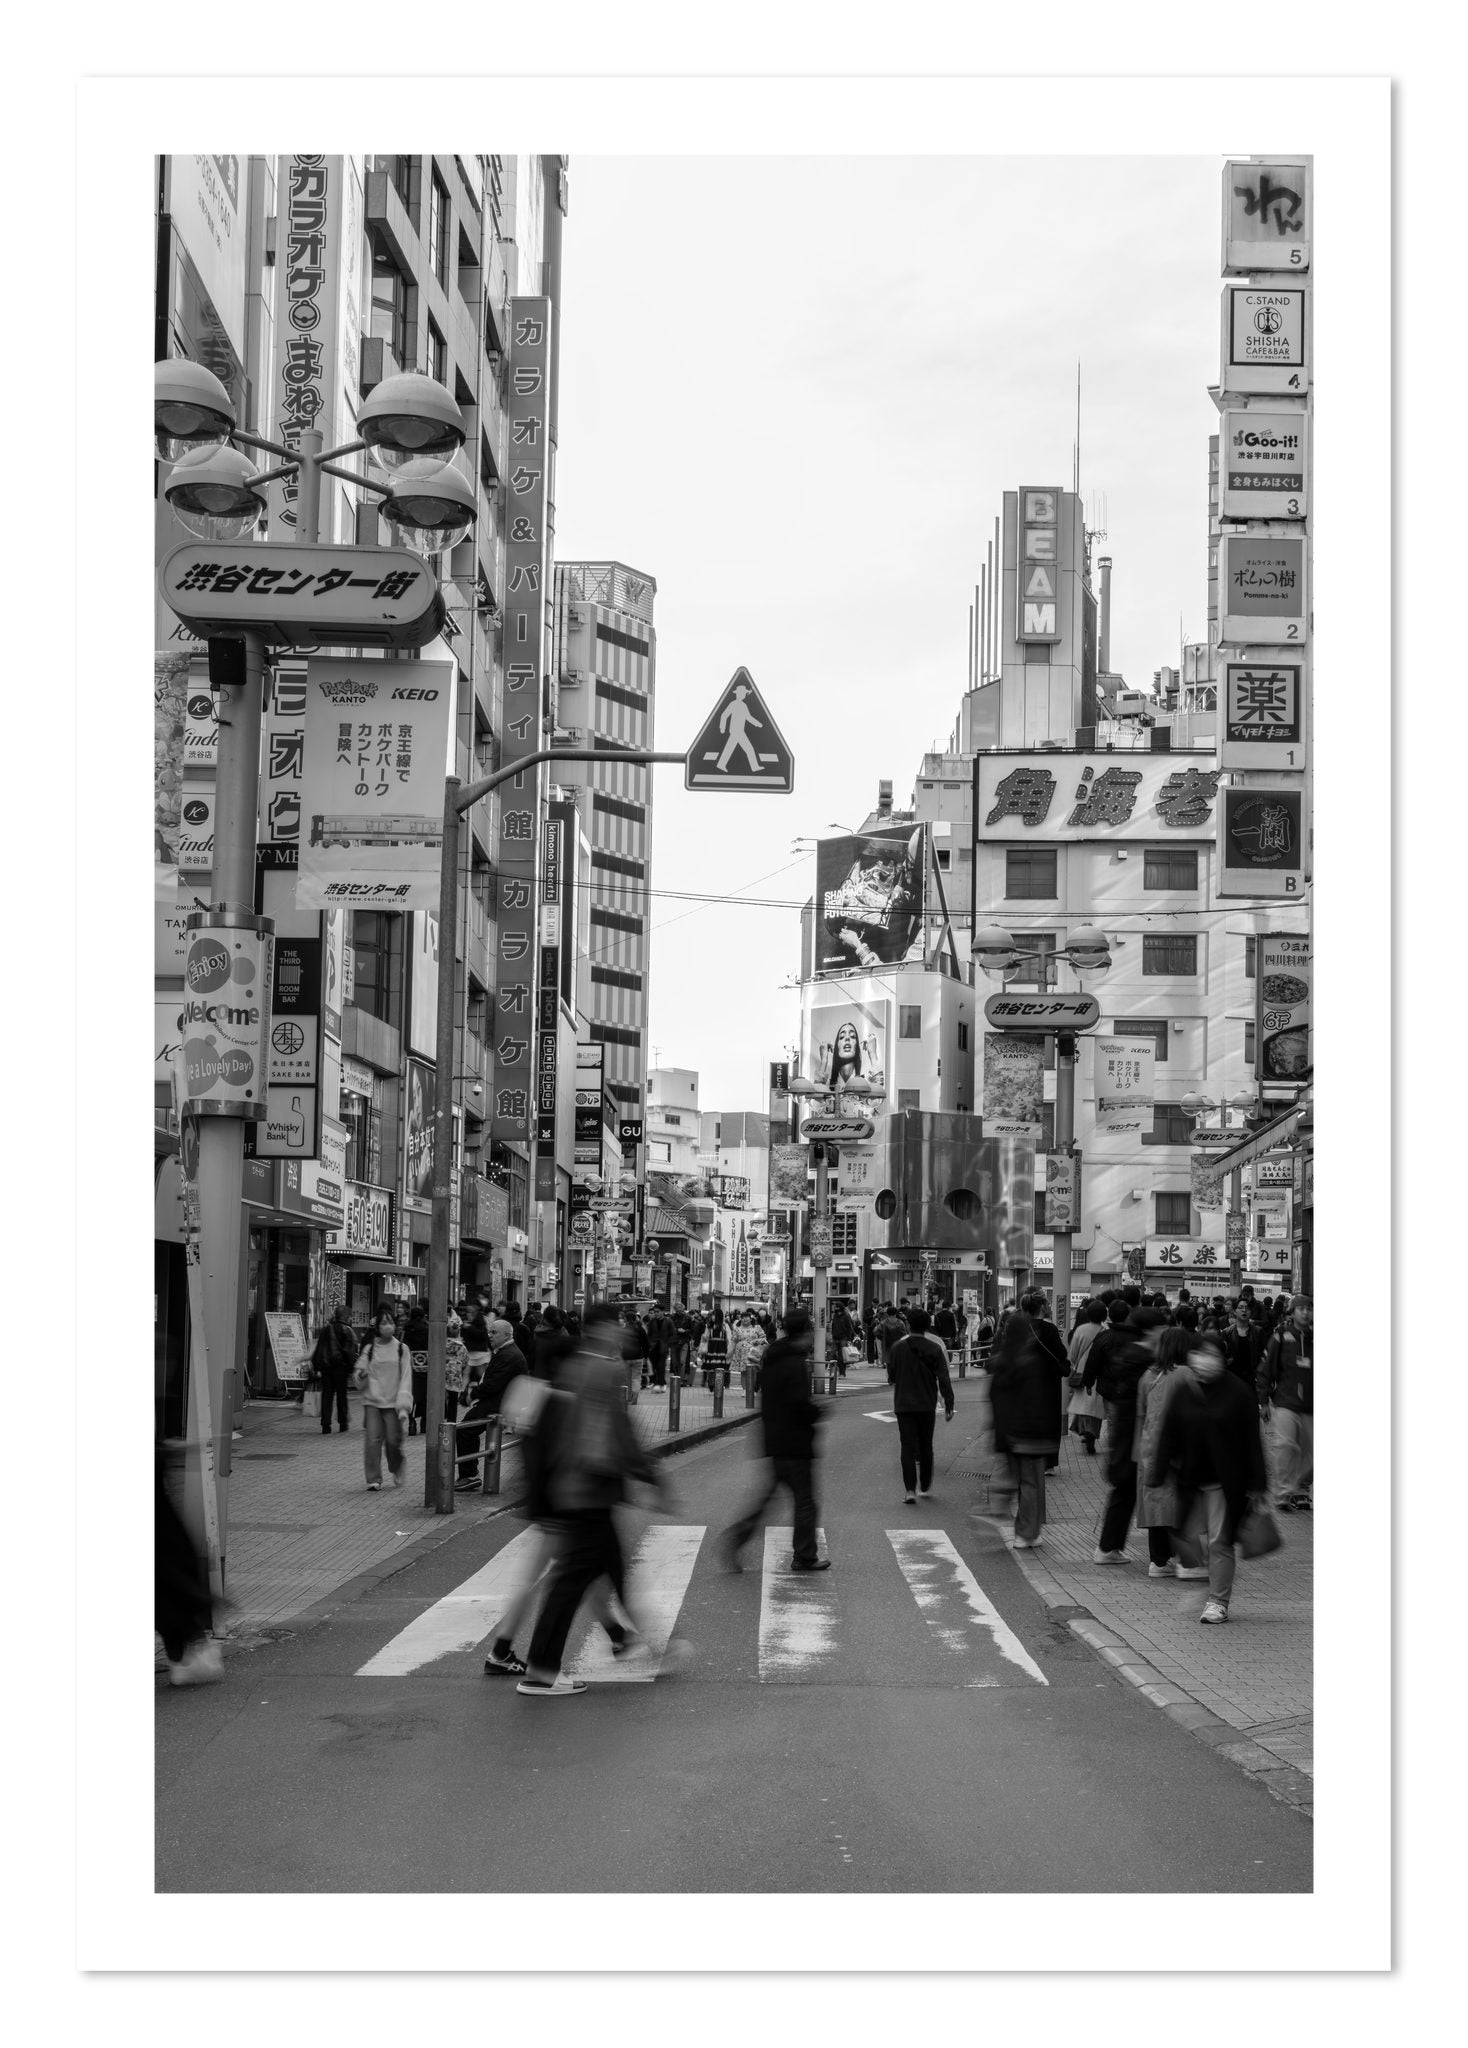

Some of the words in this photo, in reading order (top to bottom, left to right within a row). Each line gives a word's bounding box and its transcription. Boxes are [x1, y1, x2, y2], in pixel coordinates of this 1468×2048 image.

[1234, 175, 1302, 236] わん
[287, 166, 327, 302] カラオケ
[1290, 250, 1301, 264] 5
[1246, 296, 1290, 305] C.STAND
[1246, 336, 1290, 346] SHISHA
[1246, 347, 1290, 355] CAFE&BAR
[1288, 374, 1300, 388] 4
[1245, 432, 1298, 448] Goo-it!
[1238, 452, 1295, 461] 渋谷宇田川町店
[1233, 477, 1299, 488] 全身もみほぐし
[1287, 499, 1299, 515] 3
[1024, 491, 1055, 634] BEAM
[175, 563, 420, 600] 渋谷センター街
[503, 317, 544, 841] カラオケ&パーティー館
[1234, 568, 1296, 588] ポムの樹
[1287, 624, 1298, 639] 2
[332, 696, 366, 704] KANTO
[391, 688, 440, 701] KEIO
[1237, 672, 1287, 722] 薬
[1231, 725, 1292, 739] マツモトキヨシ
[336, 723, 352, 765] 冒険へ
[354, 723, 372, 796] カントーの
[374, 723, 392, 796] ポケパーク
[396, 724, 412, 783] 京王線で
[1286, 751, 1294, 765] 1
[986, 766, 1221, 826] 角海老
[548, 825, 556, 860] kimono
[184, 856, 208, 864] 渋谷店
[324, 884, 411, 896] 渋谷センター街
[1285, 877, 1297, 892] B
[188, 952, 227, 986] Enjoy
[1265, 955, 1309, 967] 四川料理
[497, 880, 531, 1120] カラオケ館
[184, 1001, 260, 1026] Welcome
[992, 1002, 1092, 1016] 渋谷センター街
[1263, 1011, 1291, 1030] 6F
[201, 1057, 231, 1078] Lovely
[232, 1059, 253, 1073] Day!
[267, 1123, 300, 1133] Whisky
[621, 1126, 641, 1137] GU
[804, 1123, 865, 1132] 渋谷センター街
[267, 1132, 287, 1140] Bank
[738, 1241, 747, 1283] BEER
[1160, 1243, 1217, 1265] 兆楽
